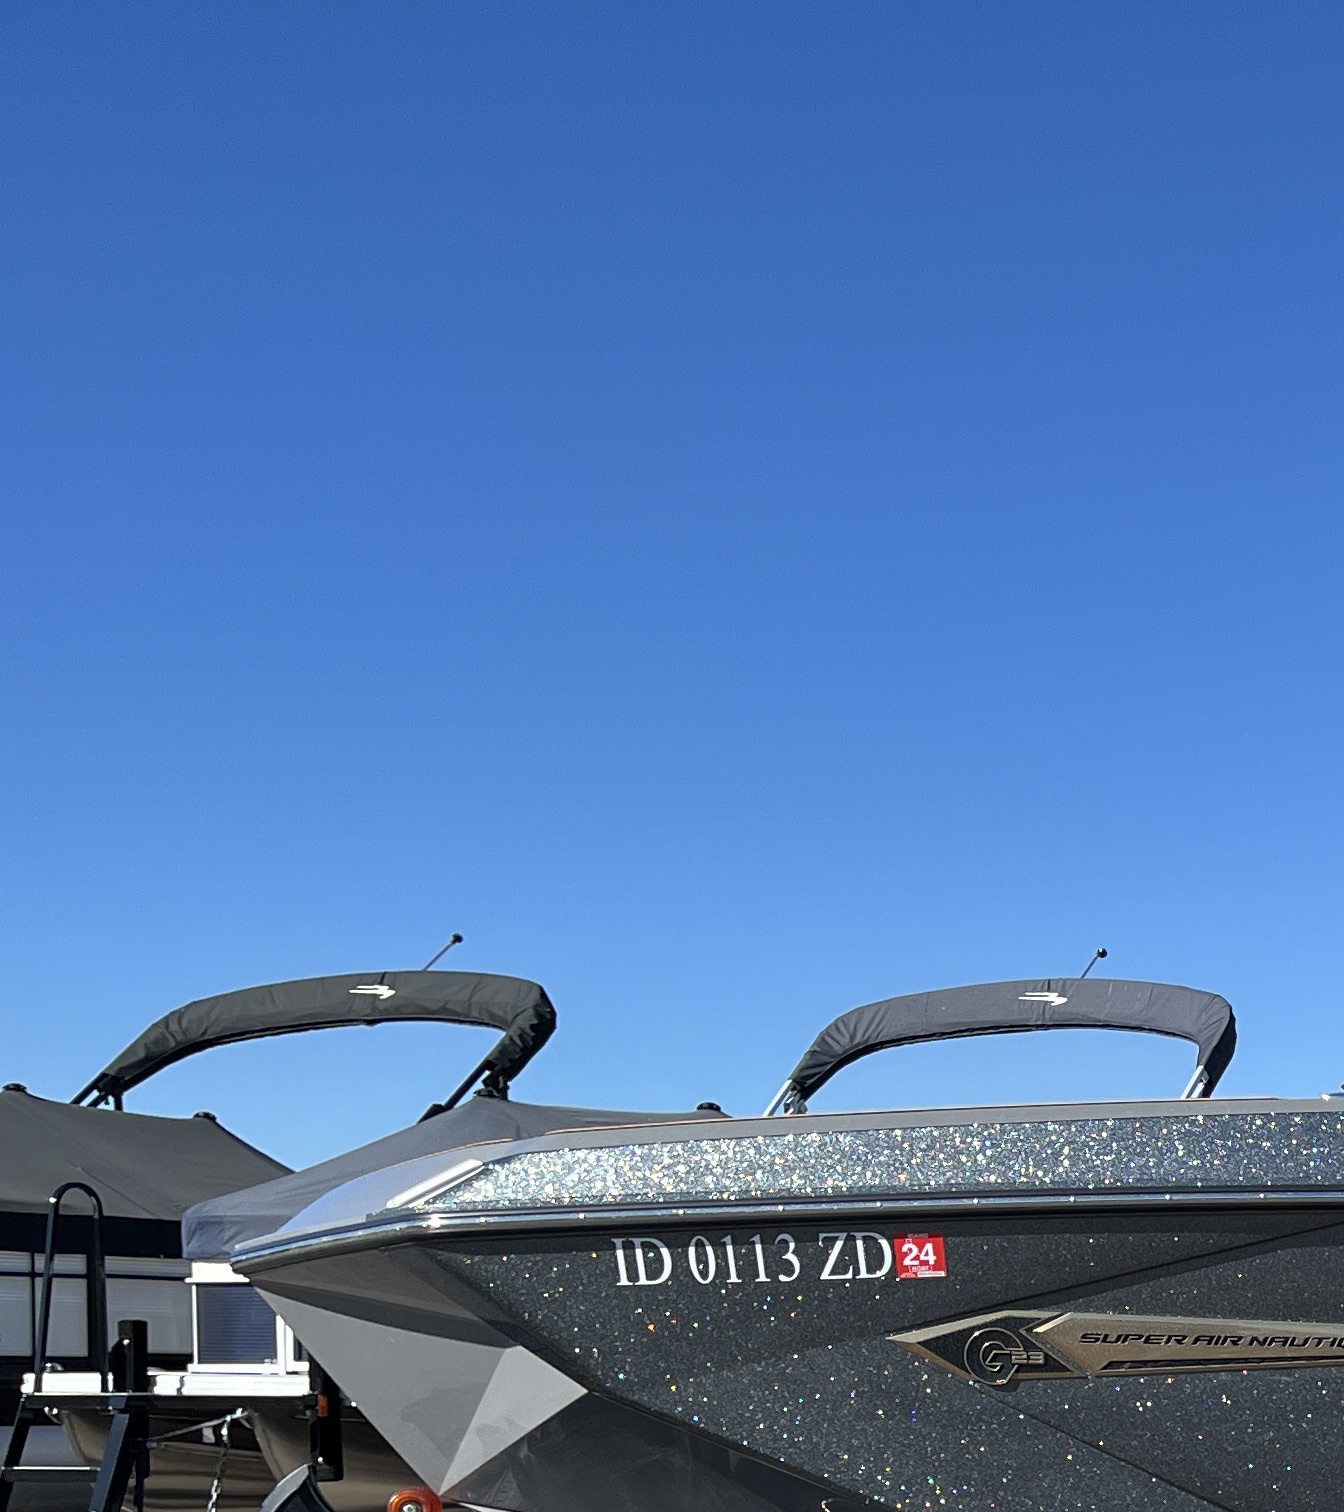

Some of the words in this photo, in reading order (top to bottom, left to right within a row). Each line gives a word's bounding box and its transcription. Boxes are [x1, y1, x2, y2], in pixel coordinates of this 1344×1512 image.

[611, 1236, 673, 1287] ID
[688, 1234, 800, 1285] 0113
[817, 1231, 893, 1282] ZD
[901, 1242, 937, 1266] 24
[1078, 1331, 1188, 1347] SUPER
[1190, 1332, 1243, 1347] AIR
